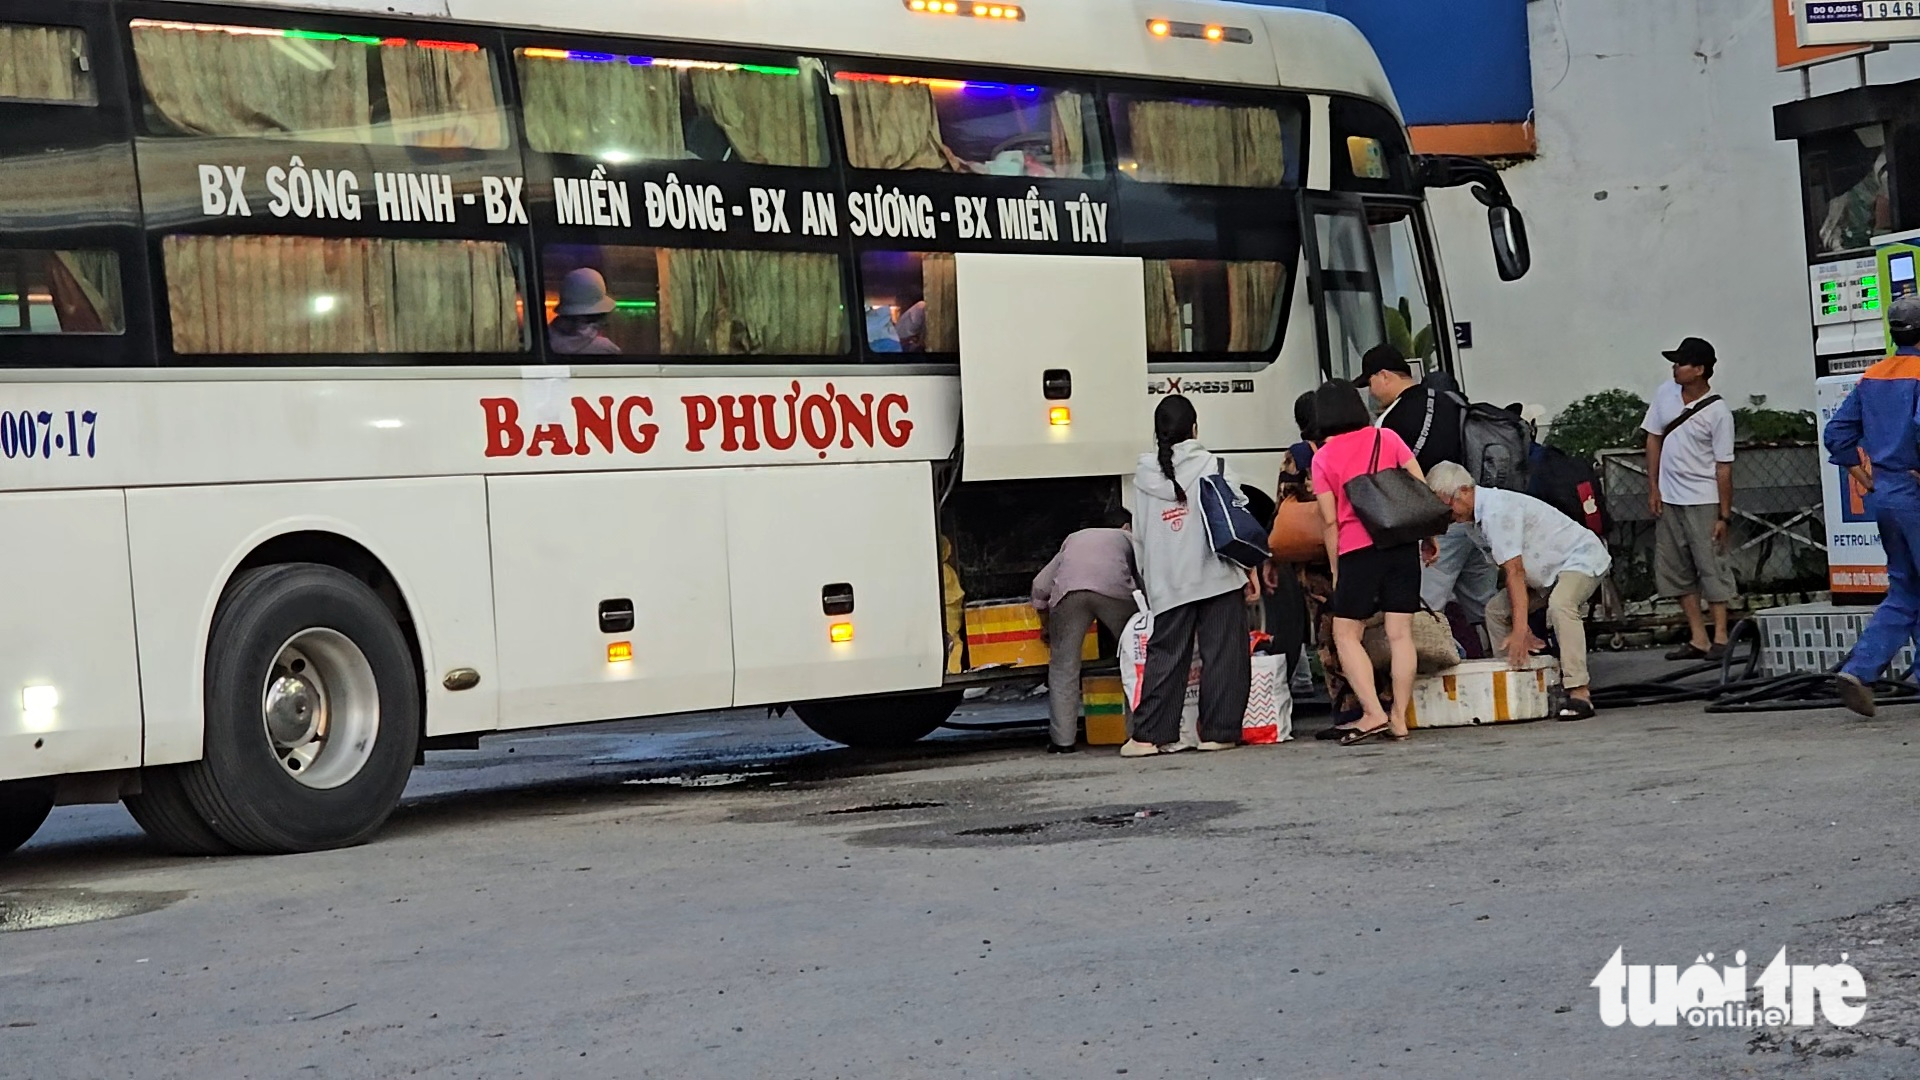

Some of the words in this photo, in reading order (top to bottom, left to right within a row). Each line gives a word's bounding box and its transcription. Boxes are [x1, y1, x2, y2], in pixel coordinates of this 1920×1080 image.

[1813, 6, 1826, 14] DO
[198, 164, 252, 217] BX
[265, 155, 362, 221] SÔNG
[373, 171, 456, 223] HINH
[481, 176, 529, 224] BX
[552, 164, 632, 228] MIỀN
[643, 172, 727, 232] ĐÔNG
[749, 187, 792, 234] BX
[801, 189, 839, 237] AN
[848, 183, 937, 240] SƯƠNG
[955, 195, 993, 240] BX
[996, 185, 1059, 243] MIỀN
[1064, 192, 1109, 244] TÂY
[680, 380, 914, 460] PHƯỢNG
